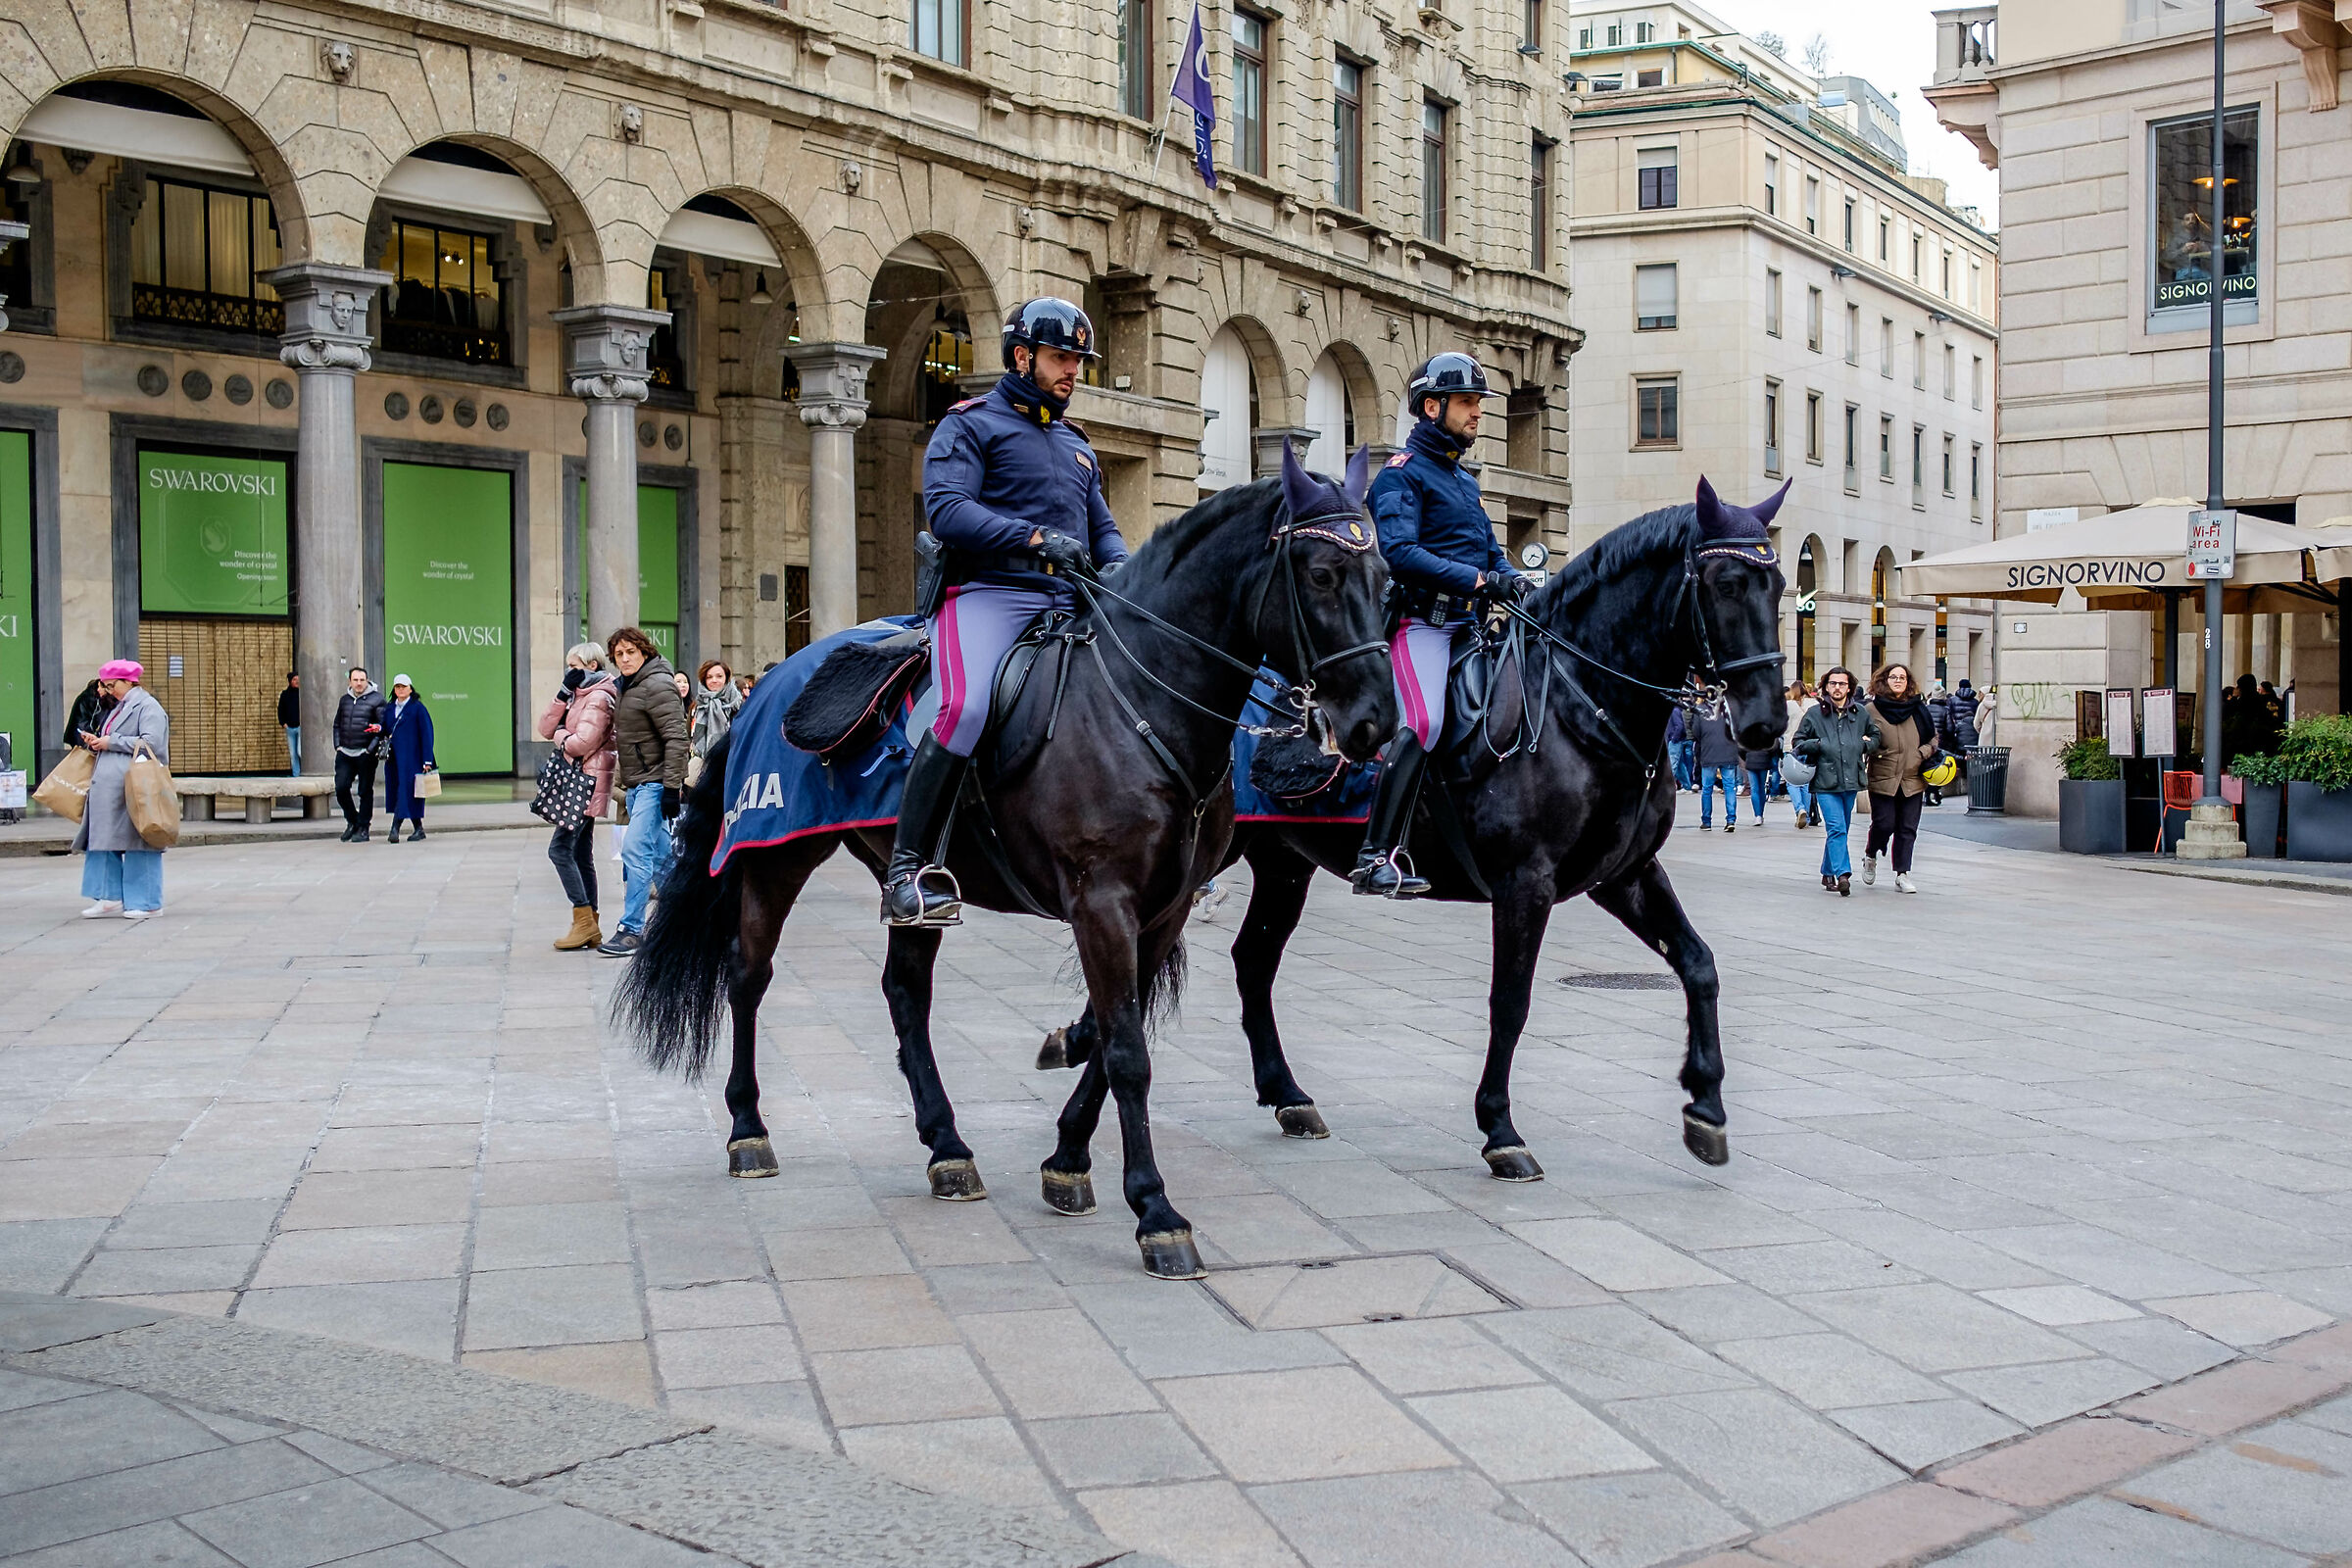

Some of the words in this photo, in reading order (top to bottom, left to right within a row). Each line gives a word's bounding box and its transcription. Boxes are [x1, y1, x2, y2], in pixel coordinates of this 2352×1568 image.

[2160, 276, 2256, 300] SIGNOINO
[150, 468, 275, 496] SWAROVSKI
[2193, 525, 2220, 537] Wi-Fi
[234, 550, 264, 559] Discover
[2192, 539, 2220, 549] area
[2007, 562, 2166, 588] SIGNORVINO
[393, 624, 502, 646] SWAROVSKI
